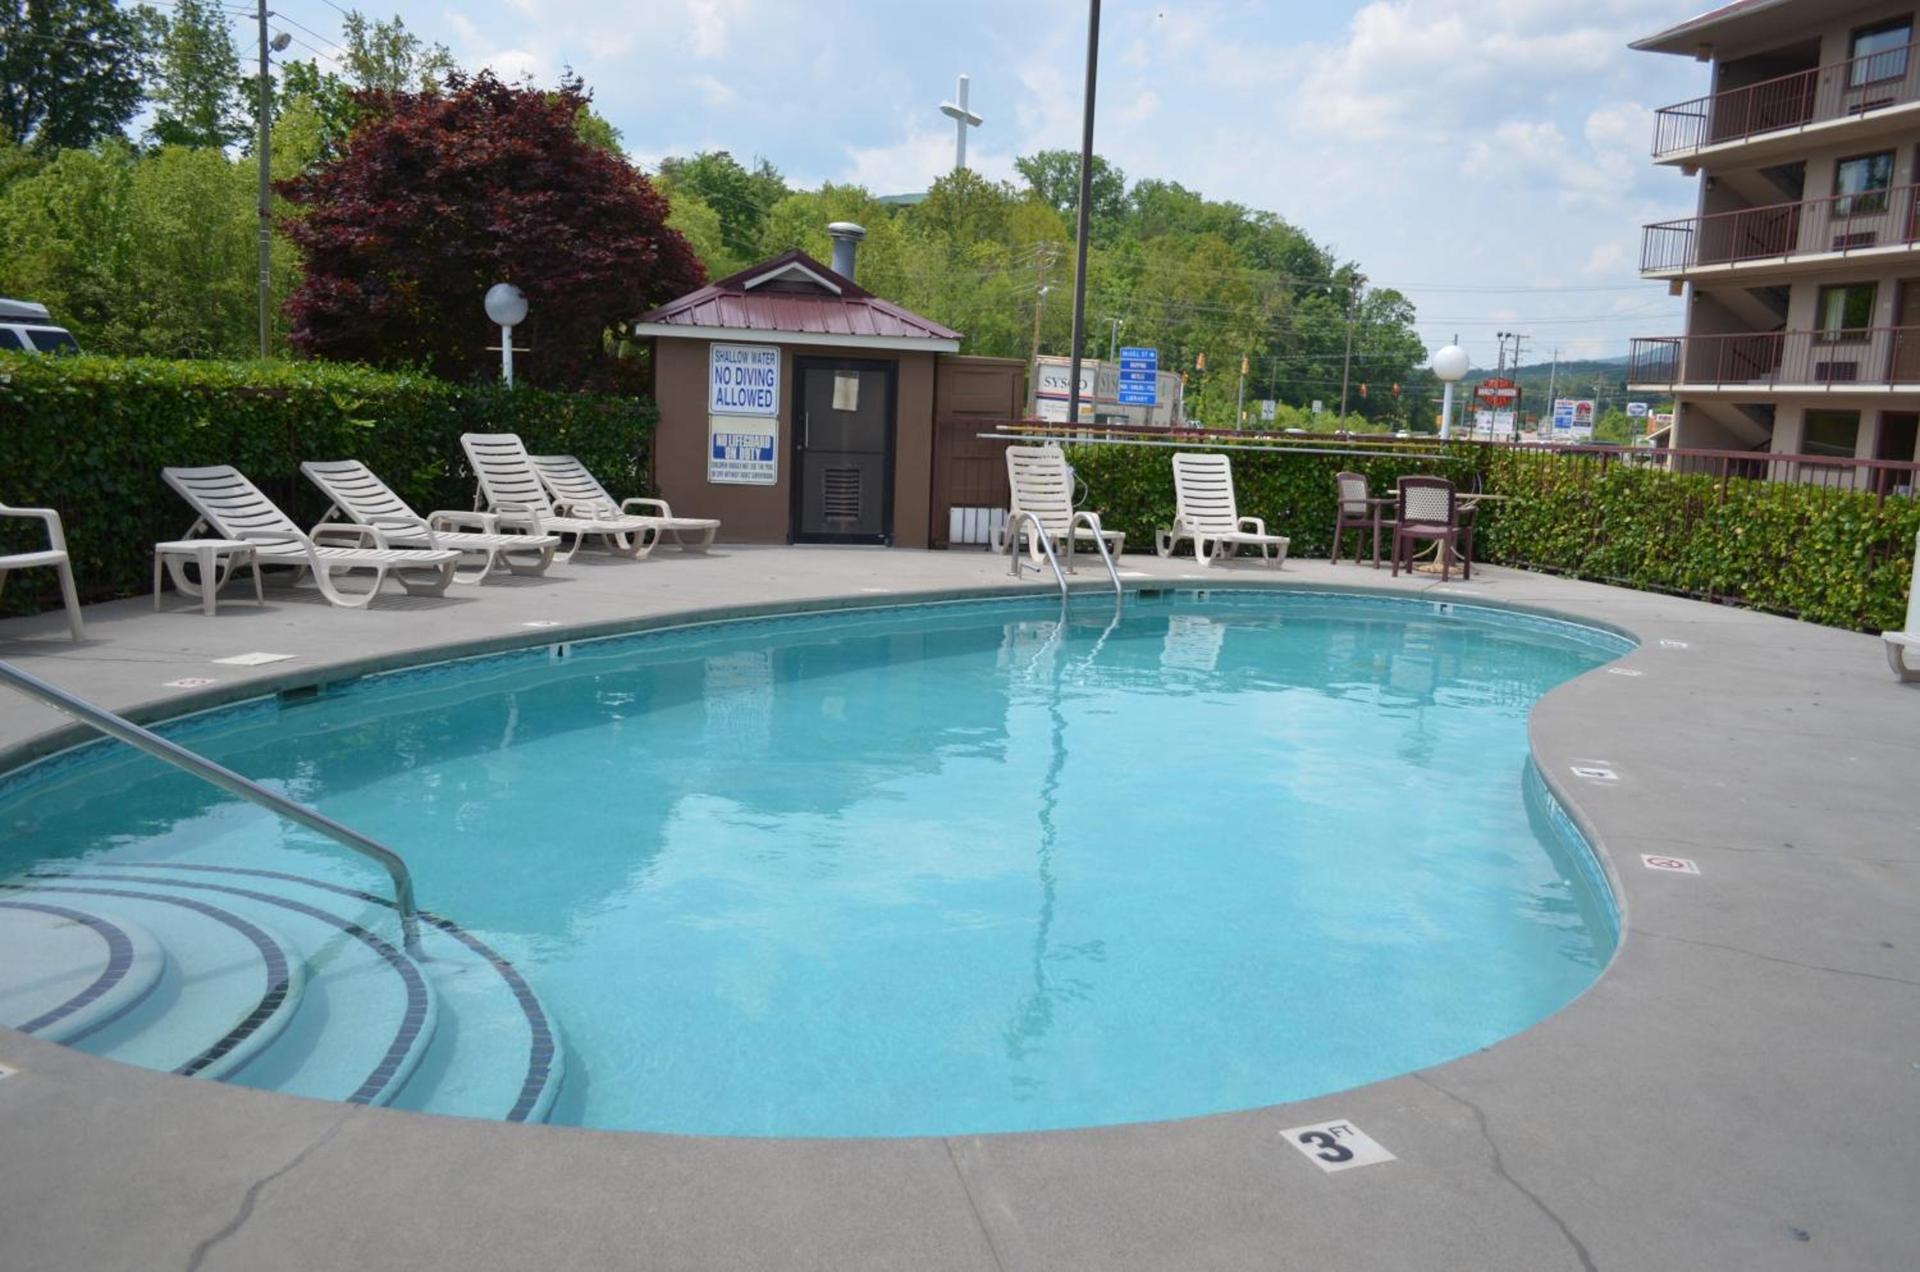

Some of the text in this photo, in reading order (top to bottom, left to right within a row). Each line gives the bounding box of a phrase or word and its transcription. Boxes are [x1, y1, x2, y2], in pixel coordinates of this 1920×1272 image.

[715, 350, 776, 365] SHALLOW WATER
[714, 366, 774, 387] NO DIVING
[1043, 375, 1088, 392] SYSO
[716, 387, 773, 407] ALLOWED
[1328, 1124, 1354, 1138] FT
[1298, 1131, 1353, 1163] 3
